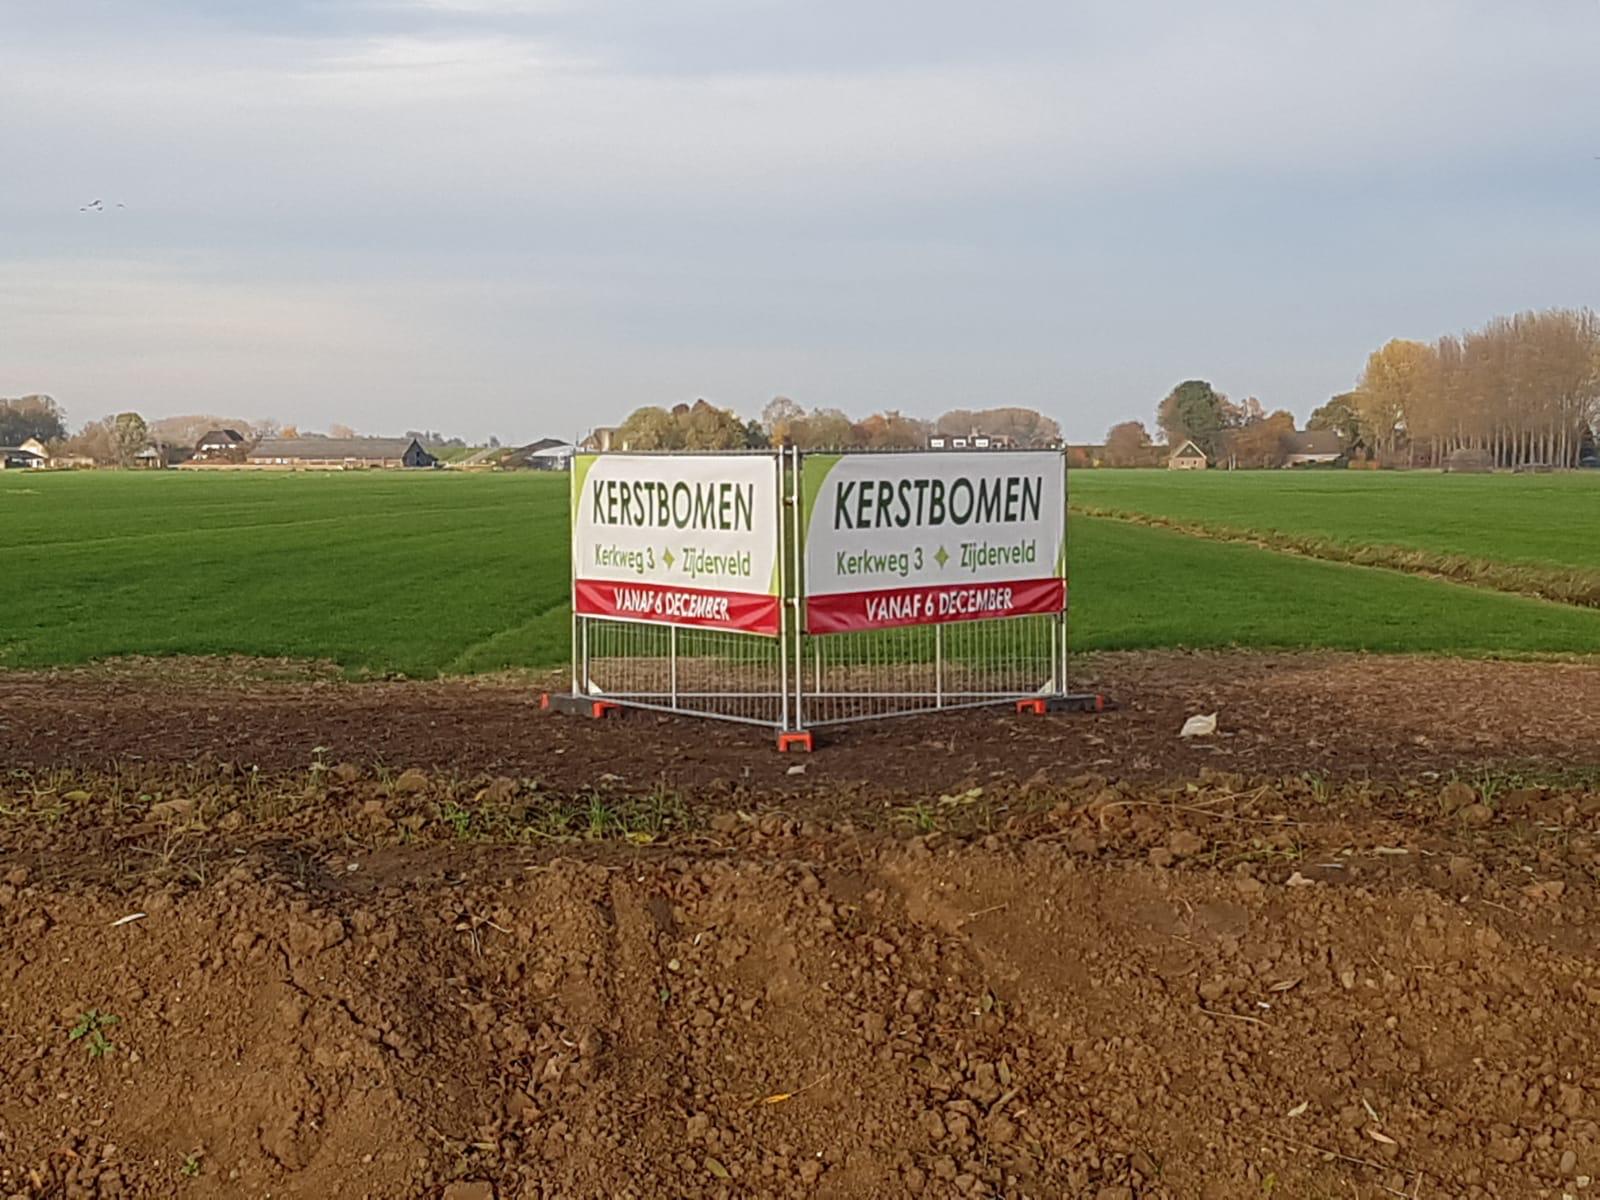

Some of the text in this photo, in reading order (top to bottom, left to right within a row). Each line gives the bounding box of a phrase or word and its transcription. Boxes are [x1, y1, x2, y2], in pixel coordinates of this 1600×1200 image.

[593, 479, 753, 531] KERSTBOMEN
[834, 476, 1042, 530] KERSTBOMEN
[595, 544, 751, 579] Kerkweg 3 Zijderveld
[837, 540, 1036, 577] Kerkweg 3 Zijderveld
[614, 587, 730, 621] VANAF 6 DECEMBER
[865, 587, 1014, 622] VANAF 6 DECEMBER
